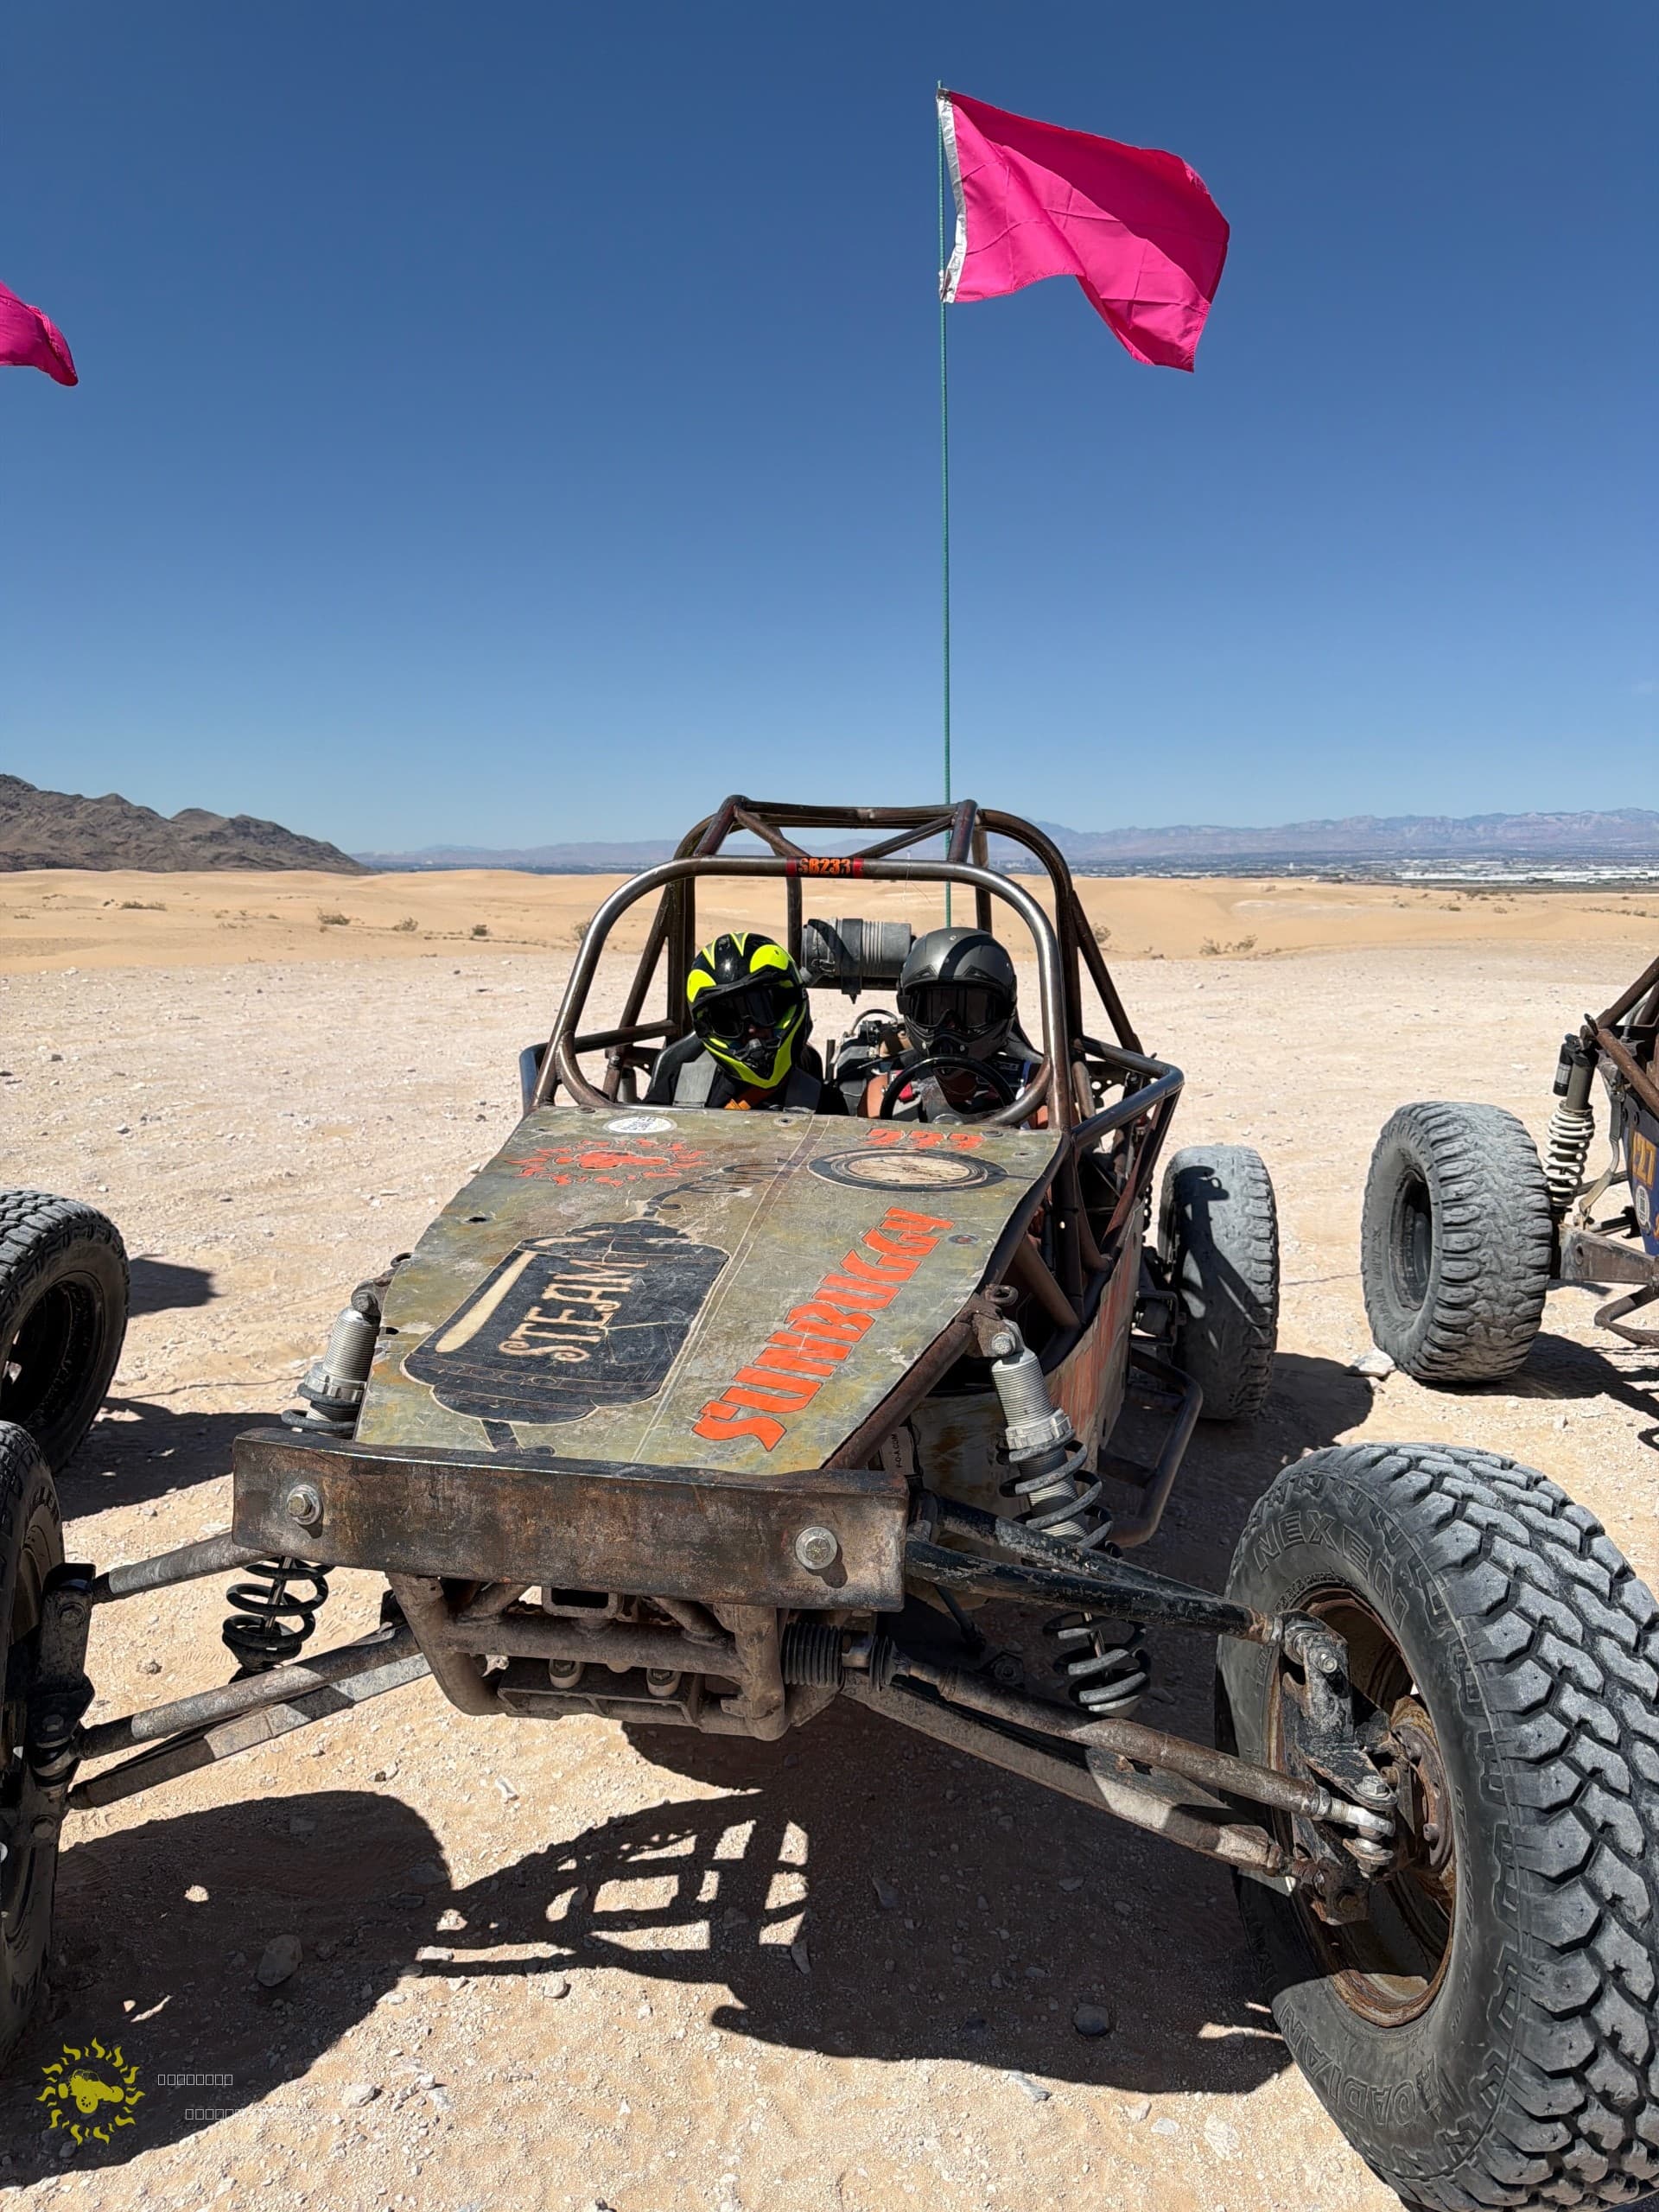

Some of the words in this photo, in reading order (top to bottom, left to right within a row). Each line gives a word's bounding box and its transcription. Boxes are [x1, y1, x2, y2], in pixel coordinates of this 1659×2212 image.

[499, 1259, 649, 1363] STEAM
[691, 1206, 955, 1452] SUNBUGGY
[1253, 1510, 1408, 1630] NEXEN
